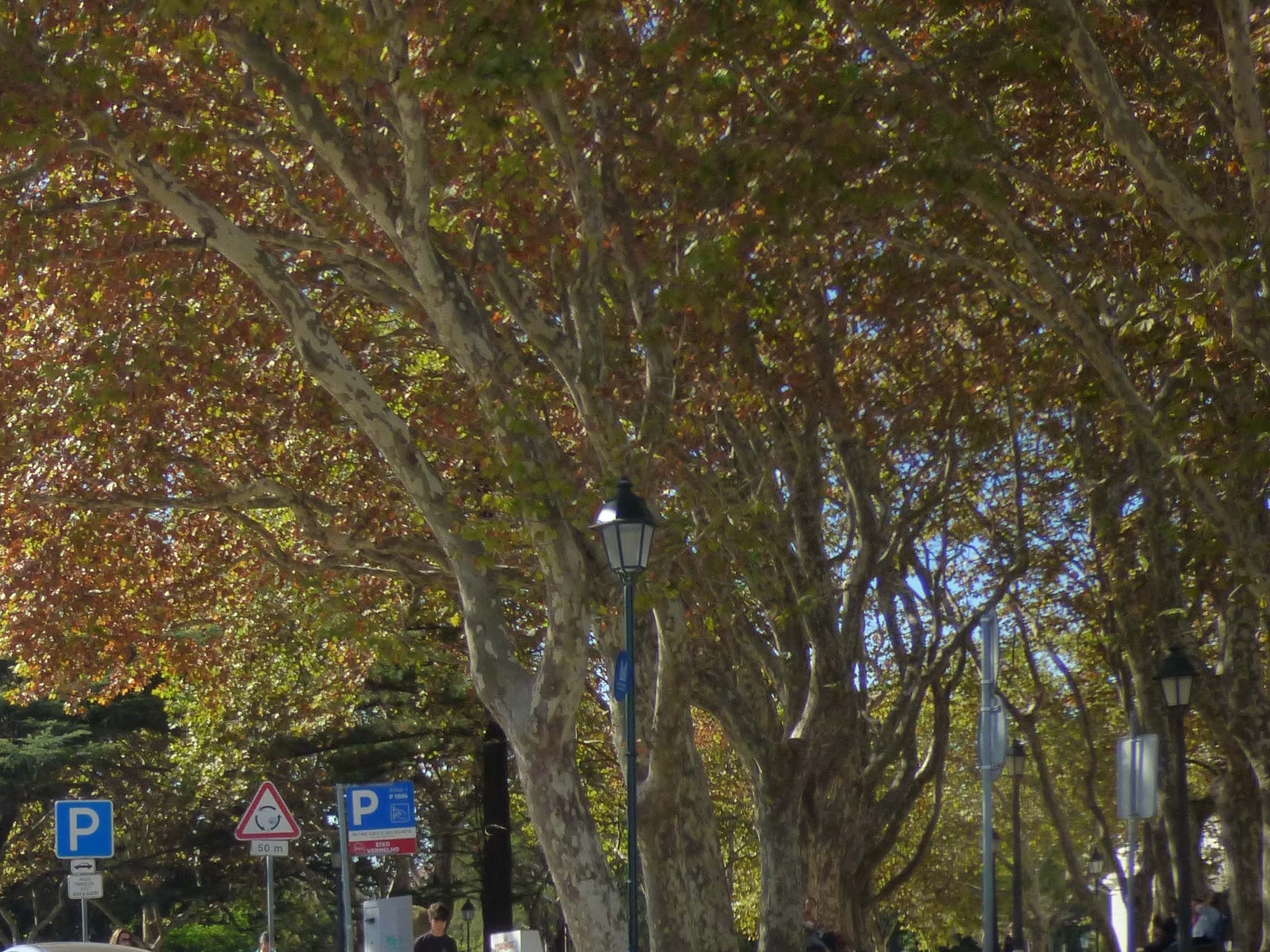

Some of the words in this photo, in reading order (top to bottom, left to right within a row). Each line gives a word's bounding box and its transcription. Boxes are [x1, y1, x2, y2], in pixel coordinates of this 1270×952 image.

[352, 789, 379, 826] P
[69, 807, 100, 851] P
[258, 844, 270, 852] 50
